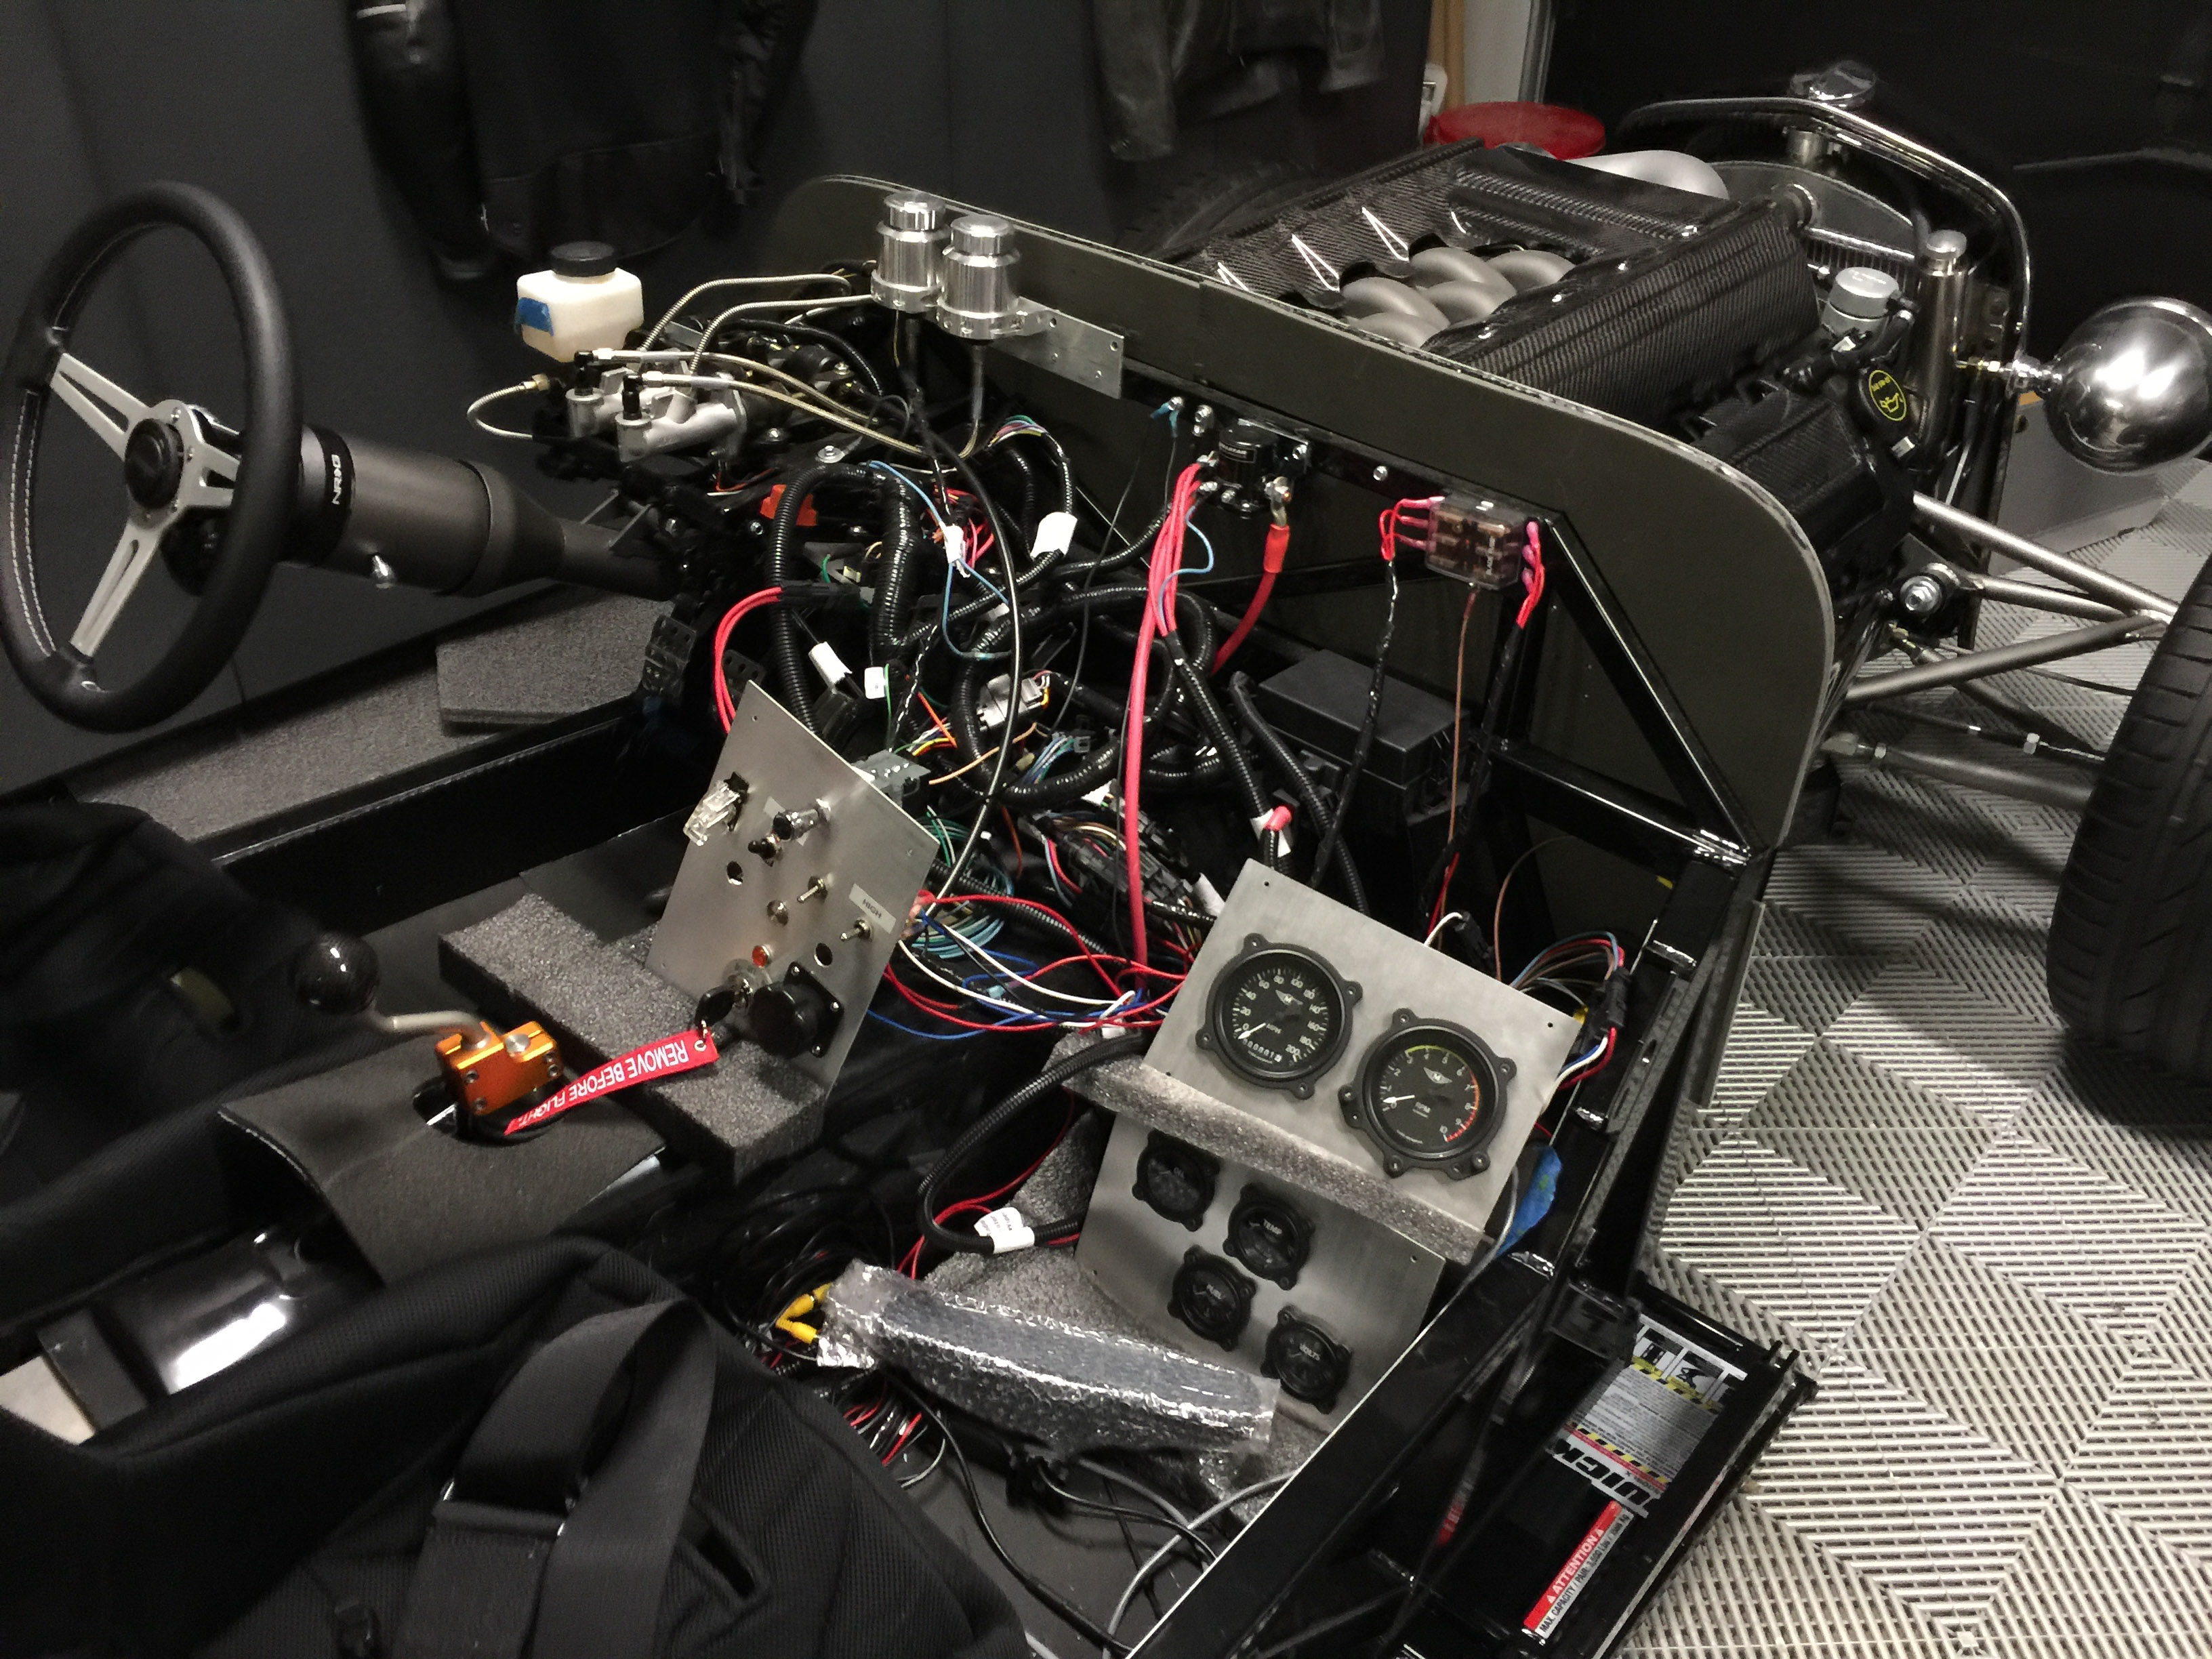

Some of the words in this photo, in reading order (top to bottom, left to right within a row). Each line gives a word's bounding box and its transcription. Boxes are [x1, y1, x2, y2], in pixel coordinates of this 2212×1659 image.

[862, 898, 883, 920] HIGH
[1246, 991, 1256, 1000] 40
[1240, 1007, 1251, 1016] 20
[1309, 1004, 1321, 1014] 140
[1307, 1021, 1320, 1031] 160
[1286, 1044, 1300, 1055] 200
[627, 1040, 689, 1078] REMOVE
[1441, 1056, 1448, 1064] 5
[1394, 1068, 1401, 1076] 2
[1456, 1068, 1463, 1076] 6
[569, 1062, 625, 1101] BEFORE
[1415, 1102, 1430, 1113] RPM
[1174, 1167, 1185, 1178] OIL
[1263, 1218, 1282, 1235] TEMP
[1299, 1343, 1321, 1361] VOLTS
[1552, 1534, 1599, 1594] ATTENTION
[1540, 1616, 1555, 1633] MAX.
[1551, 1586, 1576, 1616] CAPACITY
